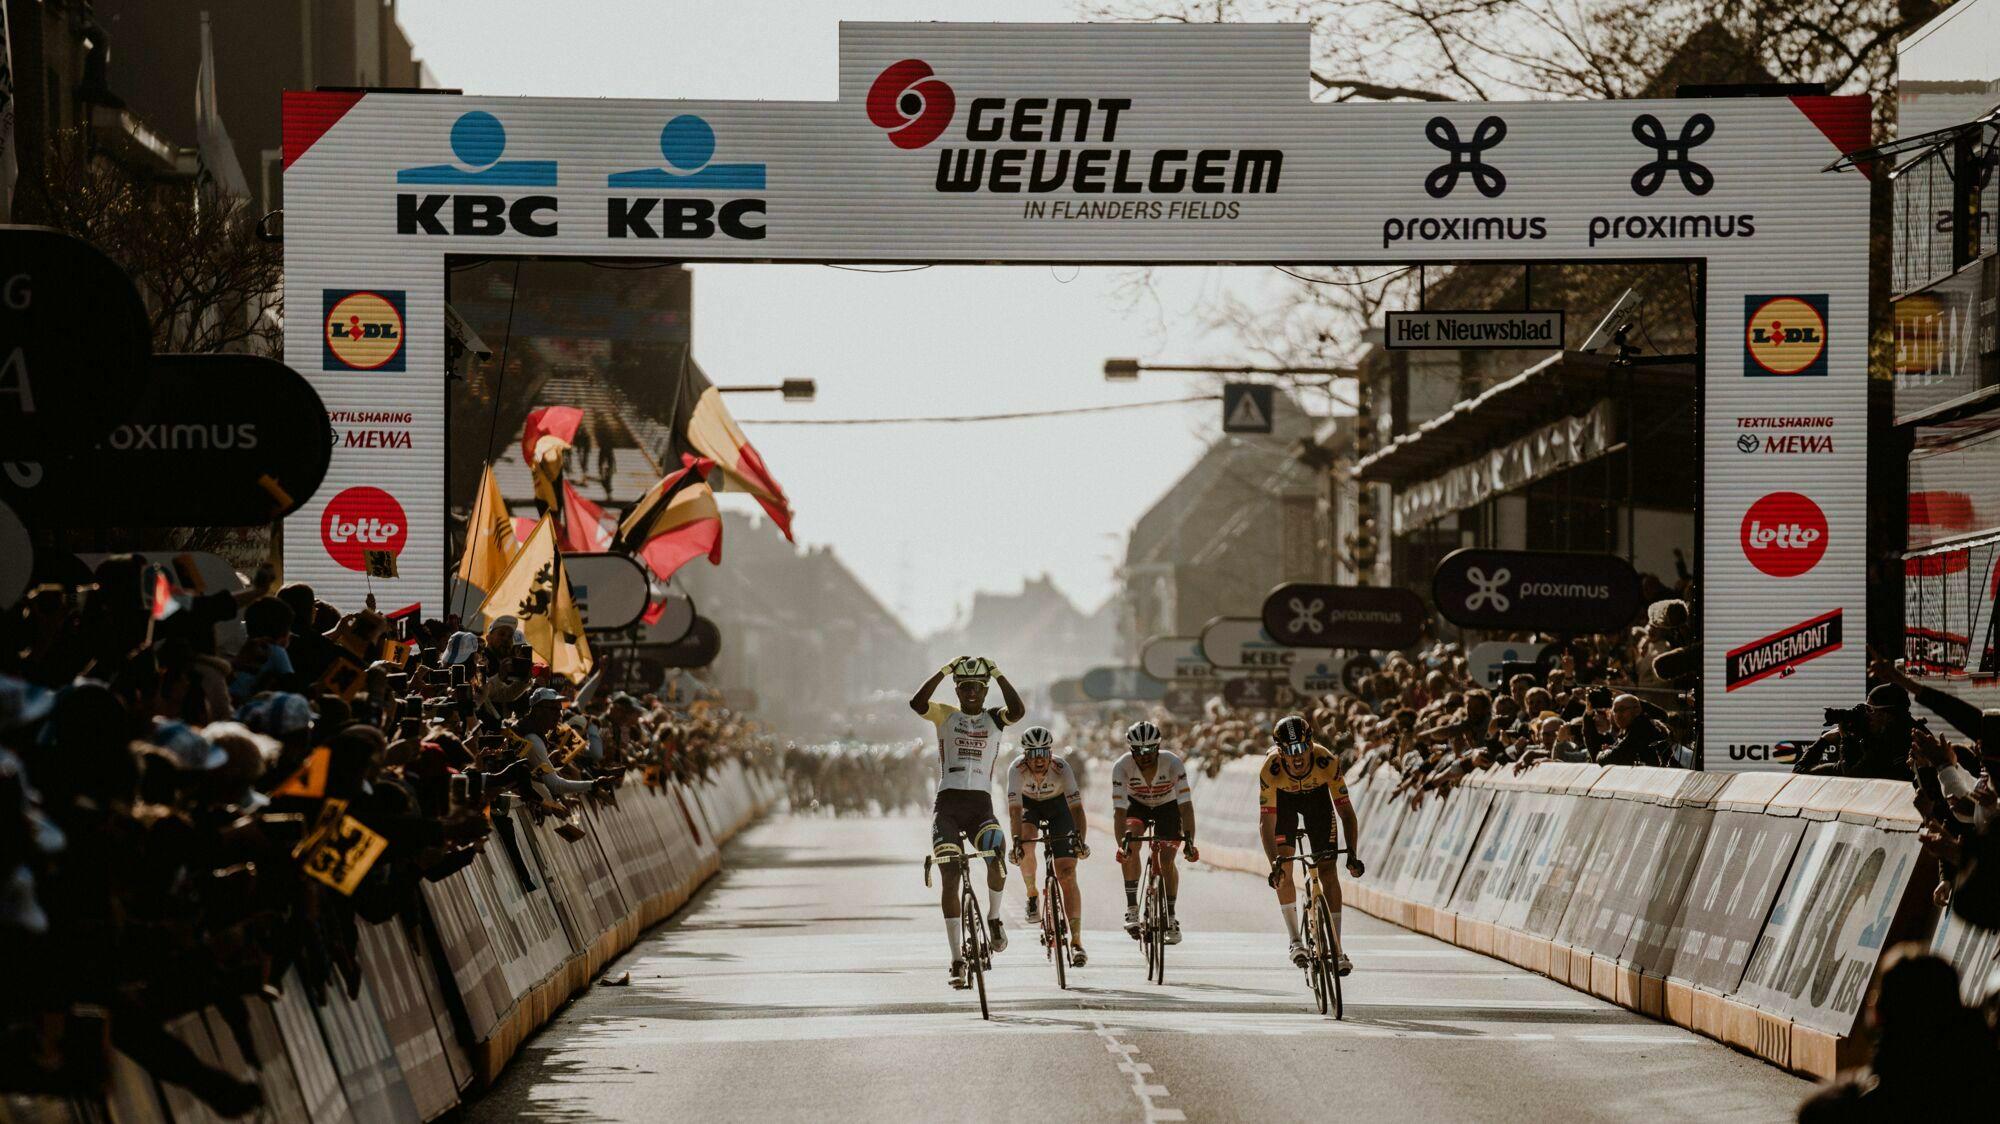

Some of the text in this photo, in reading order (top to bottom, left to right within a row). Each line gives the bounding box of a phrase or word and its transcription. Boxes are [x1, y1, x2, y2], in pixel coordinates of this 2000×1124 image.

[966, 98, 1131, 142] GENT
[935, 149, 1283, 193] WEVELGEM
[396, 194, 558, 237] KBC
[607, 198, 767, 239] KBC
[1024, 201, 1241, 220] IN FLANDERS FIELDS
[1383, 216, 1547, 249] proximus
[1588, 215, 1756, 247] proximus
[1397, 318, 1553, 341] Het Nieuwsblad
[1737, 417, 1834, 428] TEXTILSHARING
[109, 423, 258, 450] oximus
[344, 430, 412, 449] MEWA
[1765, 435, 1834, 453] MEWA
[1520, 582, 1609, 599] proximus
[1331, 610, 1402, 623] proximus
[1241, 651, 1296, 665] KBC
[1738, 622, 1831, 678] KWAREMONT
[1304, 681, 1339, 690] KBC
[1729, 745, 1769, 760] UCI
